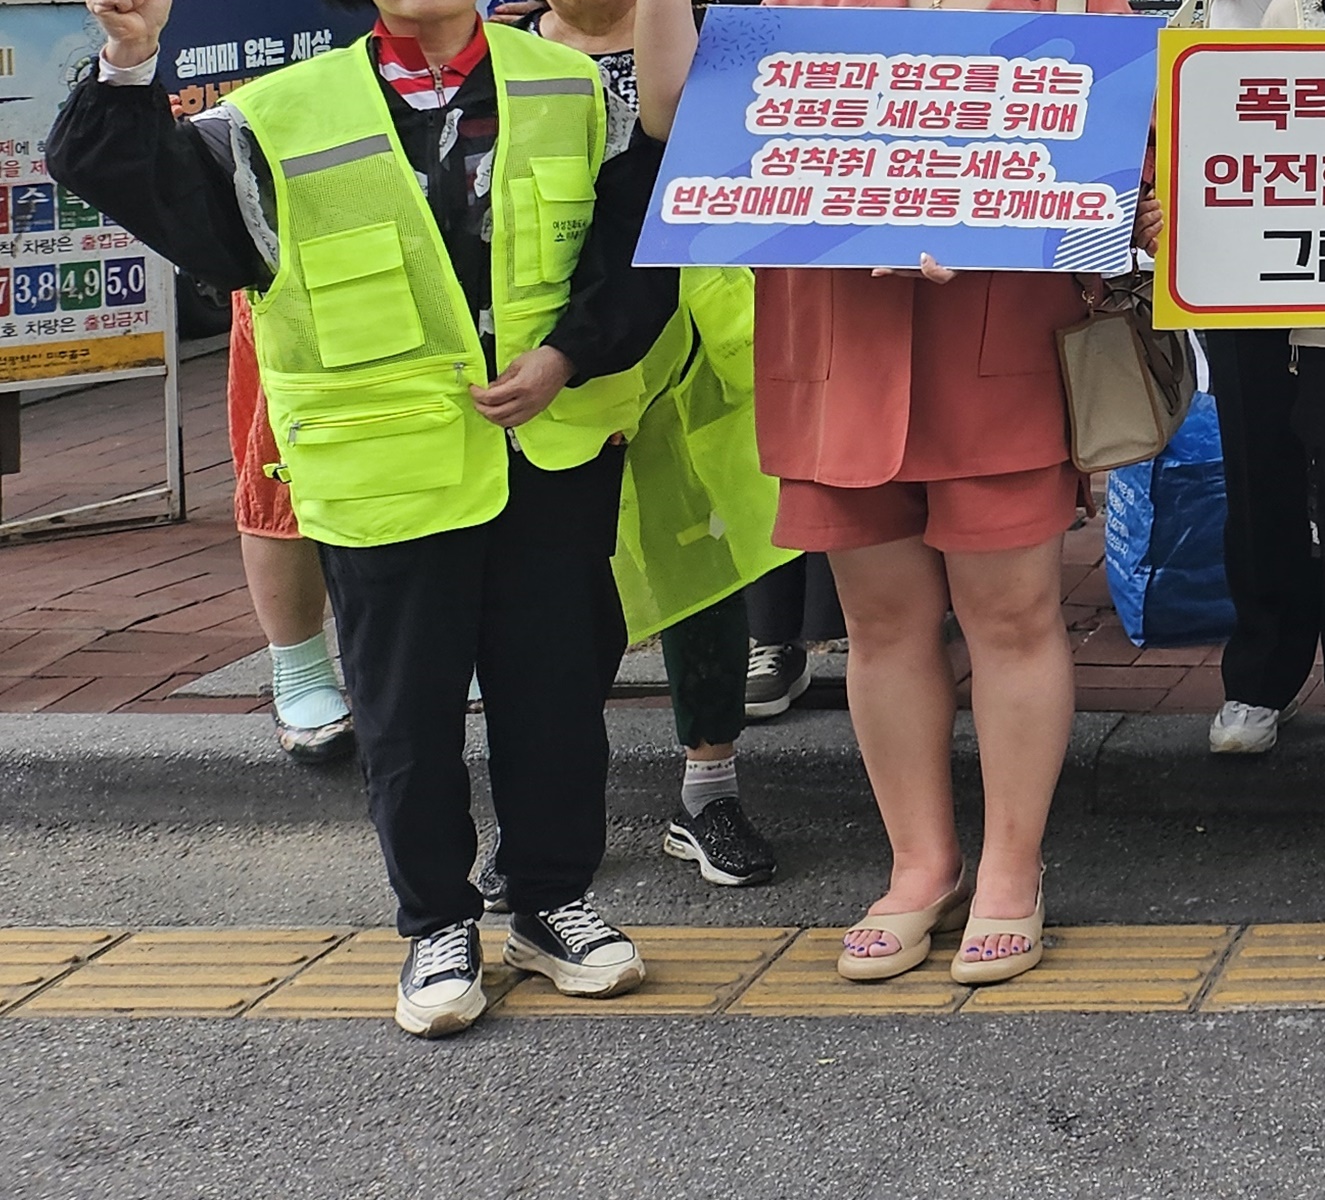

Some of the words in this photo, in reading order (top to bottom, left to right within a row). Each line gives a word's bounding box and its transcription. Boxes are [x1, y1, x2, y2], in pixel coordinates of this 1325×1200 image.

[175, 42, 239, 79] 성매매
[244, 37, 285, 68] 없는
[291, 29, 332, 61] 세상
[767, 59, 878, 91] 차별과
[889, 60, 999, 93] 혐오를
[1012, 65, 1085, 95] 넘는
[754, 99, 869, 130] 성평등
[876, 100, 990, 132] 세상을
[1003, 103, 1078, 134] 위해
[760, 147, 871, 179] 성착취
[887, 150, 1046, 184] 없는세상,
[672, 184, 811, 217] 반성매매
[822, 186, 961, 219] 공동행동
[973, 188, 1116, 222] 함께해요.
[23, 236, 73, 254] 차량은
[15, 272, 54, 308] 3,8
[62, 268, 100, 304] 4,9
[107, 264, 145, 299] 5,0
[25, 317, 77, 336] 차량은
[83, 310, 149, 331] 출입금지
